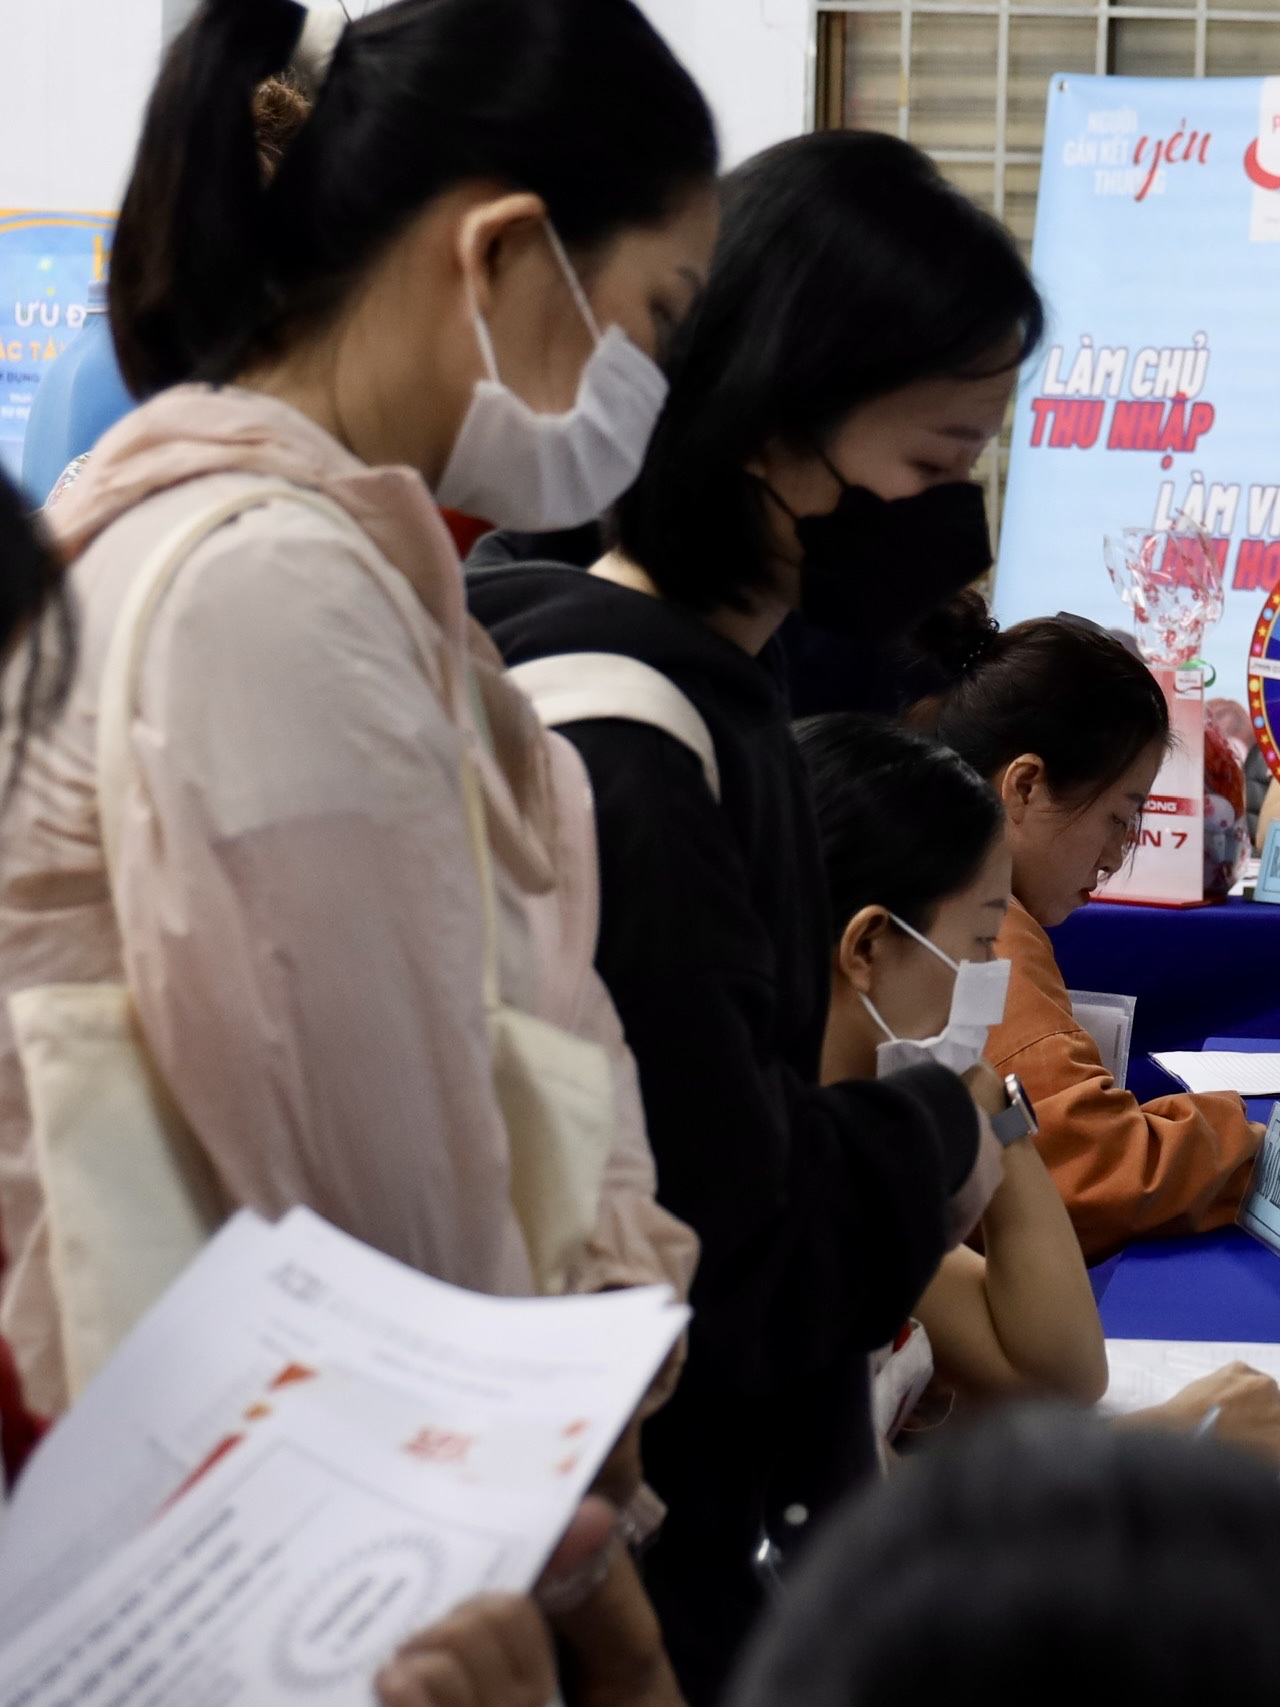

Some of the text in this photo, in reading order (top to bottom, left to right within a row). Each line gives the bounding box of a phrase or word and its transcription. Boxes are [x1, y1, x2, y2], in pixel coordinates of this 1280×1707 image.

[14, 301, 88, 329] ƯU Đ
[1042, 331, 1210, 400] LÀM CHỦ
[1030, 391, 1216, 471] THU NHẬP
[1154, 470, 1241, 536] LÀM
[1145, 800, 1177, 813] ONG
[1171, 832, 1187, 849] 7
